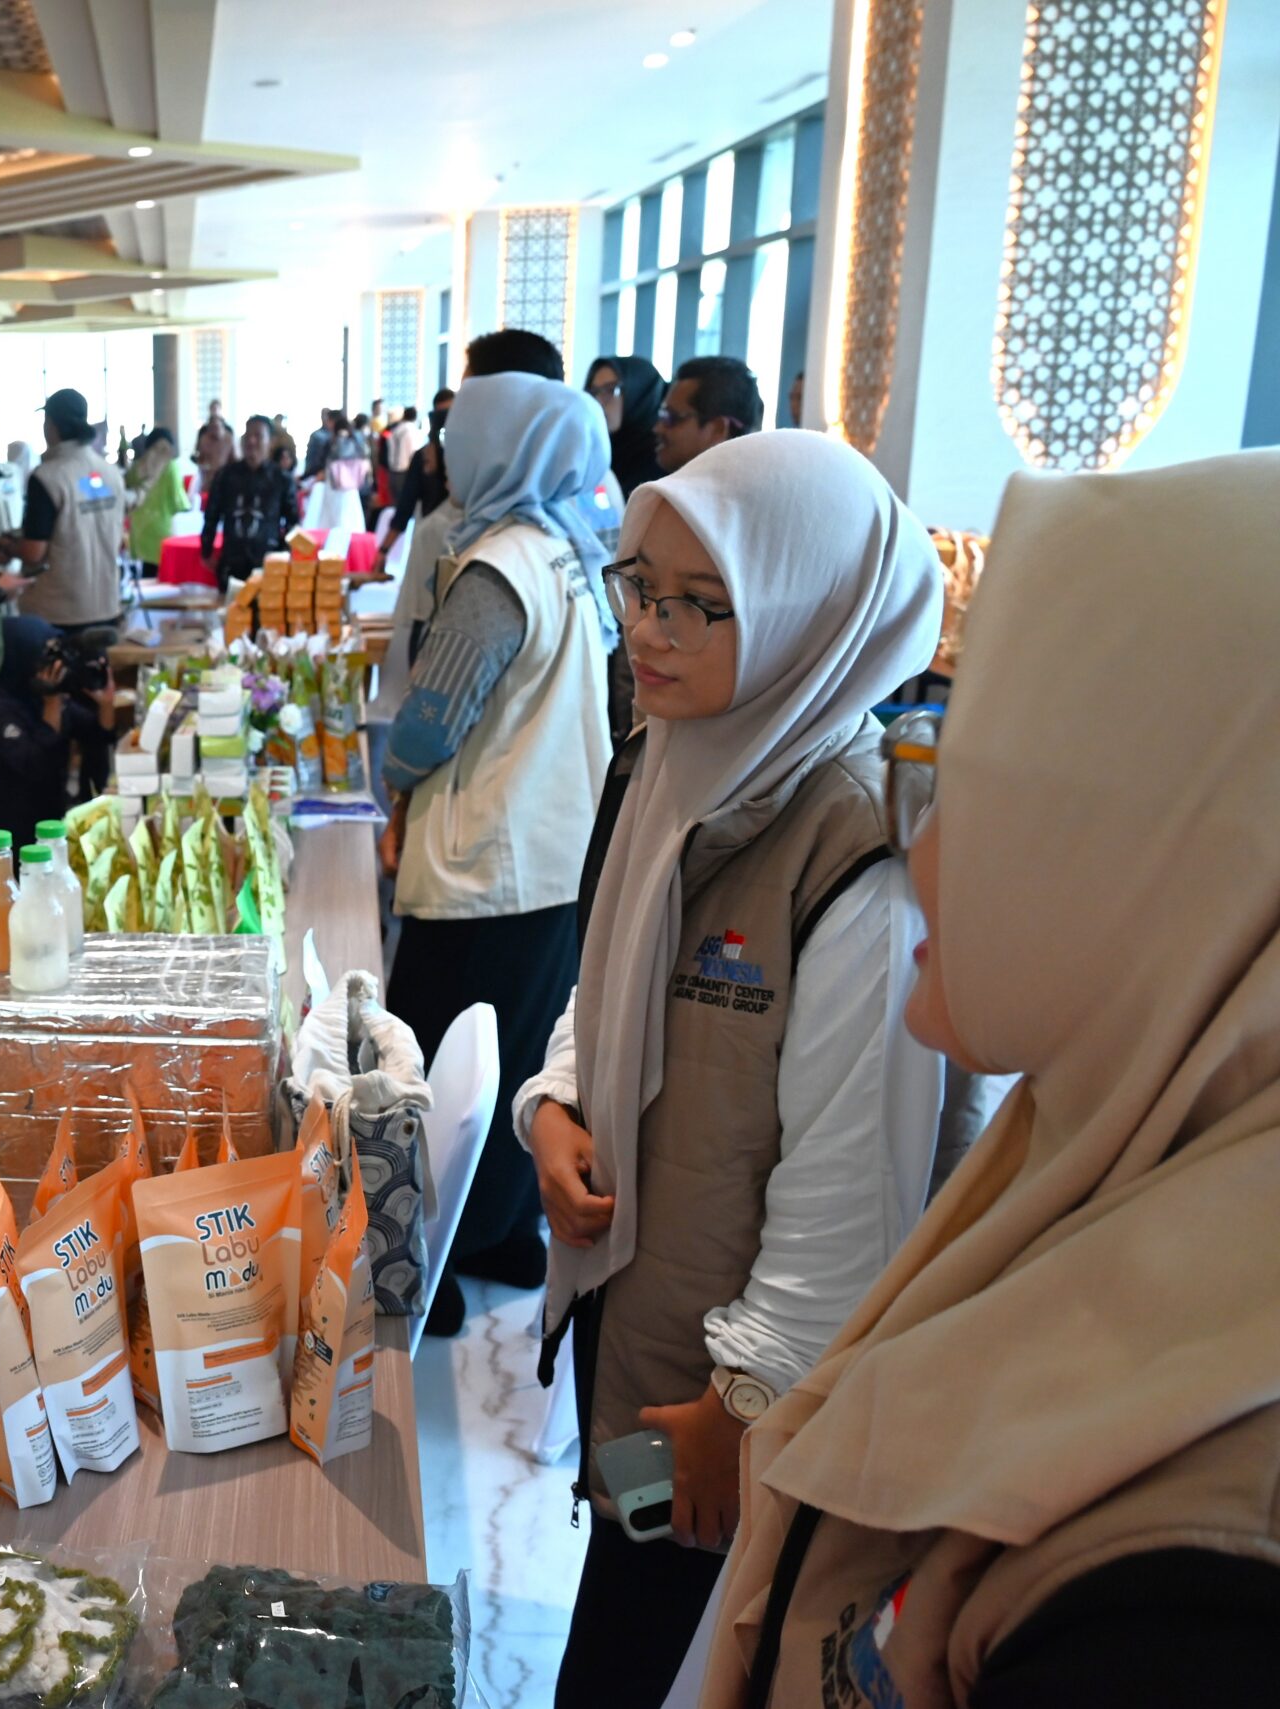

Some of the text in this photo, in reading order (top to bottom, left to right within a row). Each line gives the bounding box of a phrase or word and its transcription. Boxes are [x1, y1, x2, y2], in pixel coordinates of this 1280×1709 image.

[732, 999, 769, 1015] GROUP
[734, 985, 775, 1002] CENTER
[195, 1203, 256, 1242] STIK
[53, 1220, 99, 1268] STIK
[201, 1235, 260, 1266] Labu
[65, 1250, 107, 1291] Labu
